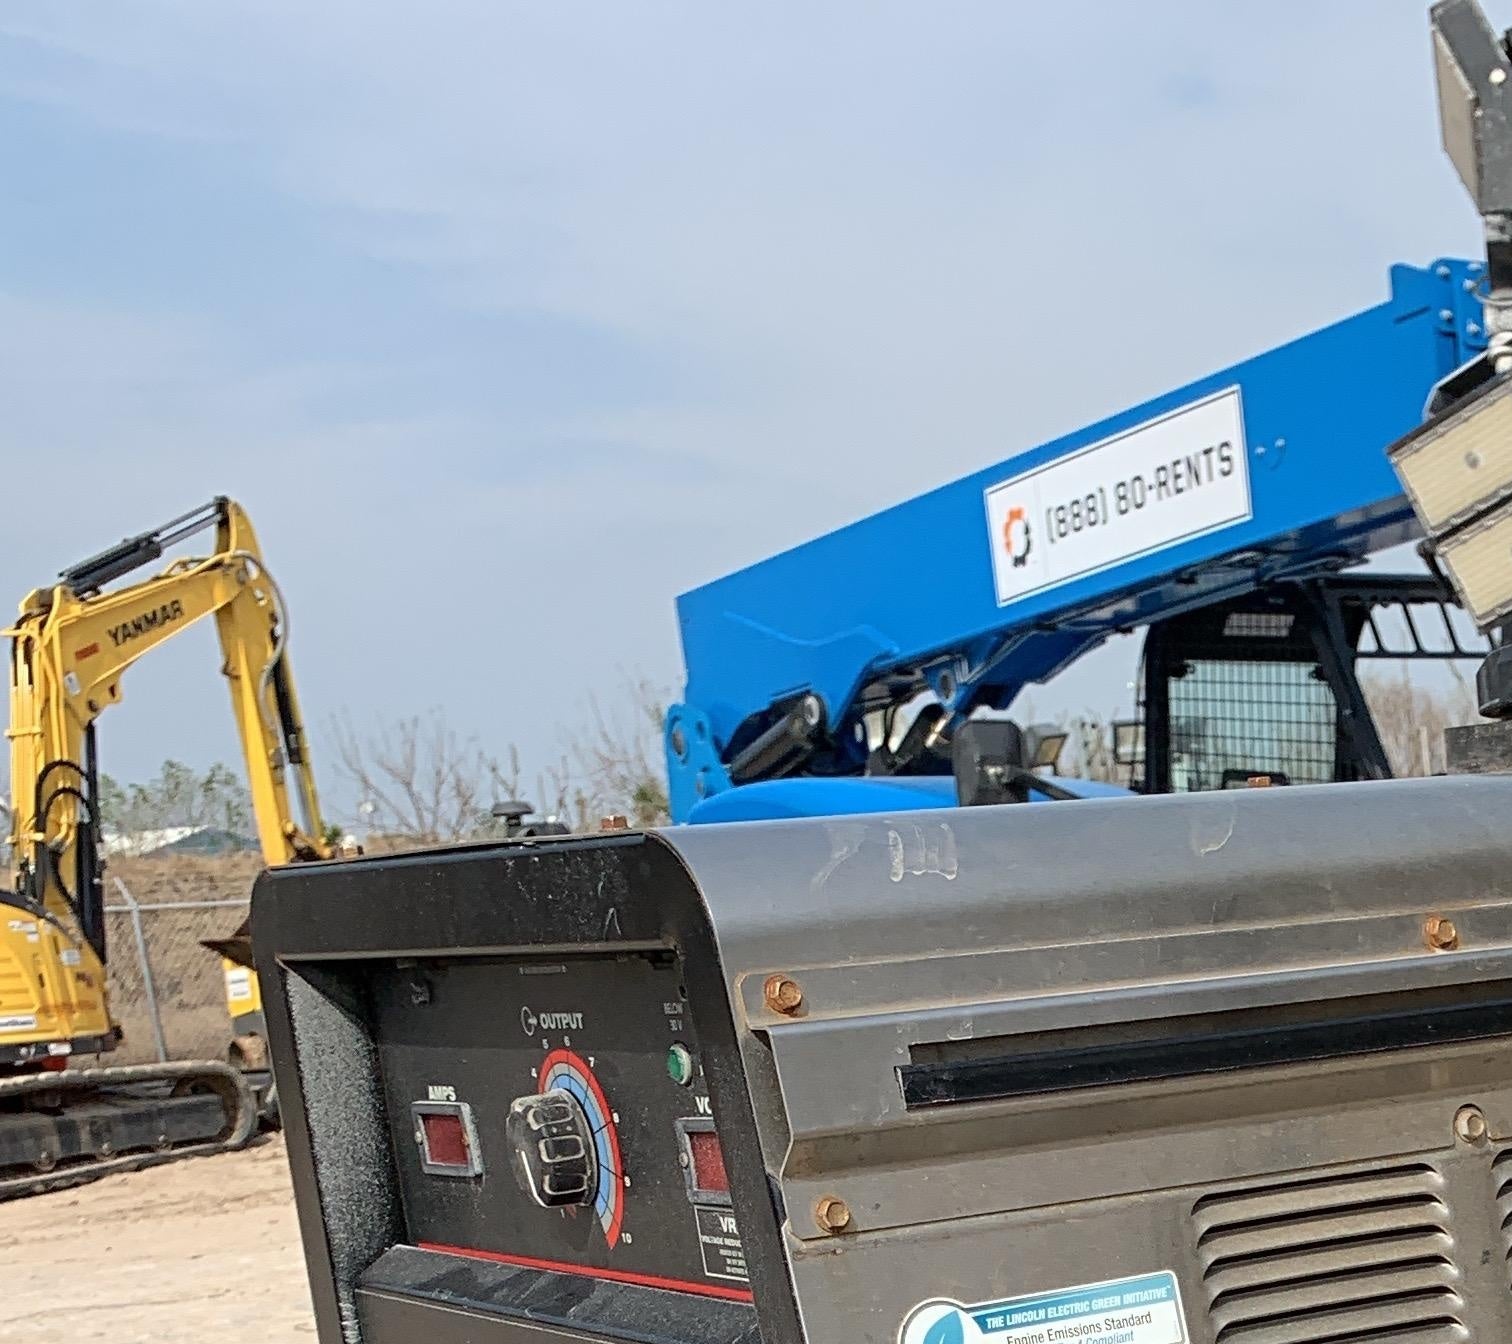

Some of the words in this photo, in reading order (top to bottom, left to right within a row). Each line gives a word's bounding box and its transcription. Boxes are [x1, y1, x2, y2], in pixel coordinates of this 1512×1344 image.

[107, 598, 185, 647] YANMAR
[540, 1012, 584, 1031] OUTPUT
[542, 1038, 550, 1050] 5
[564, 1035, 571, 1047] 6
[588, 1056, 595, 1068] 7
[428, 1085, 457, 1102] AMPS
[621, 1232, 633, 1245] 10
[986, 1315, 1005, 1330] THE
[1005, 1308, 1047, 1328] LINCOLN
[1046, 1300, 1091, 1321] ELECTRIC
[1090, 1295, 1122, 1314] GREEN
[1045, 1319, 1103, 1343] Emissions
[1104, 1310, 1153, 1331] Standard
